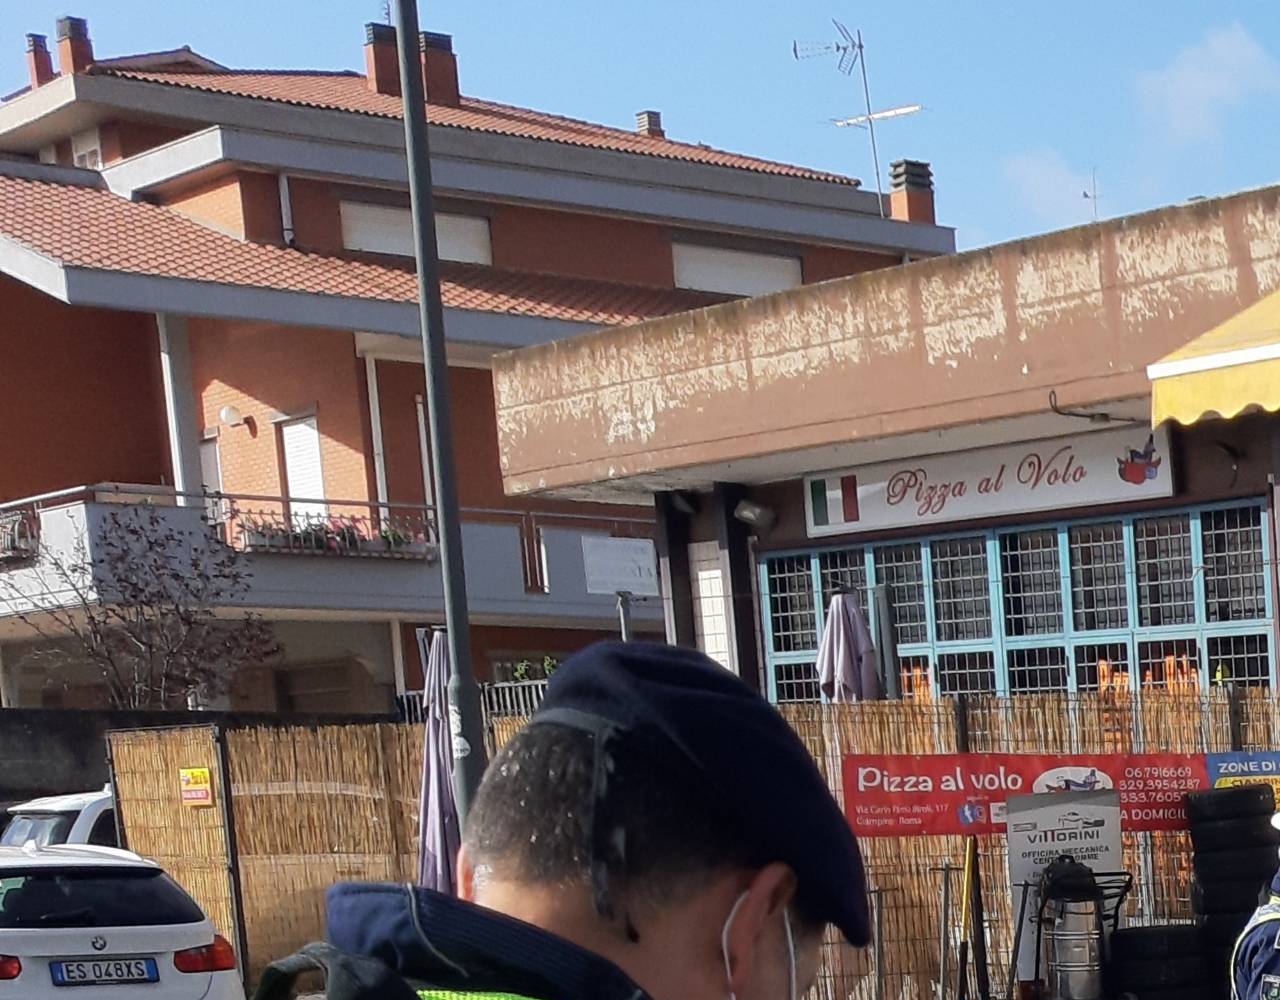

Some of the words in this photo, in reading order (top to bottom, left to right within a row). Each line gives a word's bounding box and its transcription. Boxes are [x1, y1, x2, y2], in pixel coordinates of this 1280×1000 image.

[886, 468, 967, 516] Pizza
[977, 465, 1004, 494] al
[1016, 446, 1087, 490] Volo
[1218, 762, 1258, 773] ZONE
[1263, 761, 1277, 772] DI
[857, 767, 934, 793] Pizza
[940, 766, 964, 792] al
[970, 765, 1023, 791] volo
[1061, 845, 1110, 855] MECCANICA
[65, 963, 87, 980] ES
